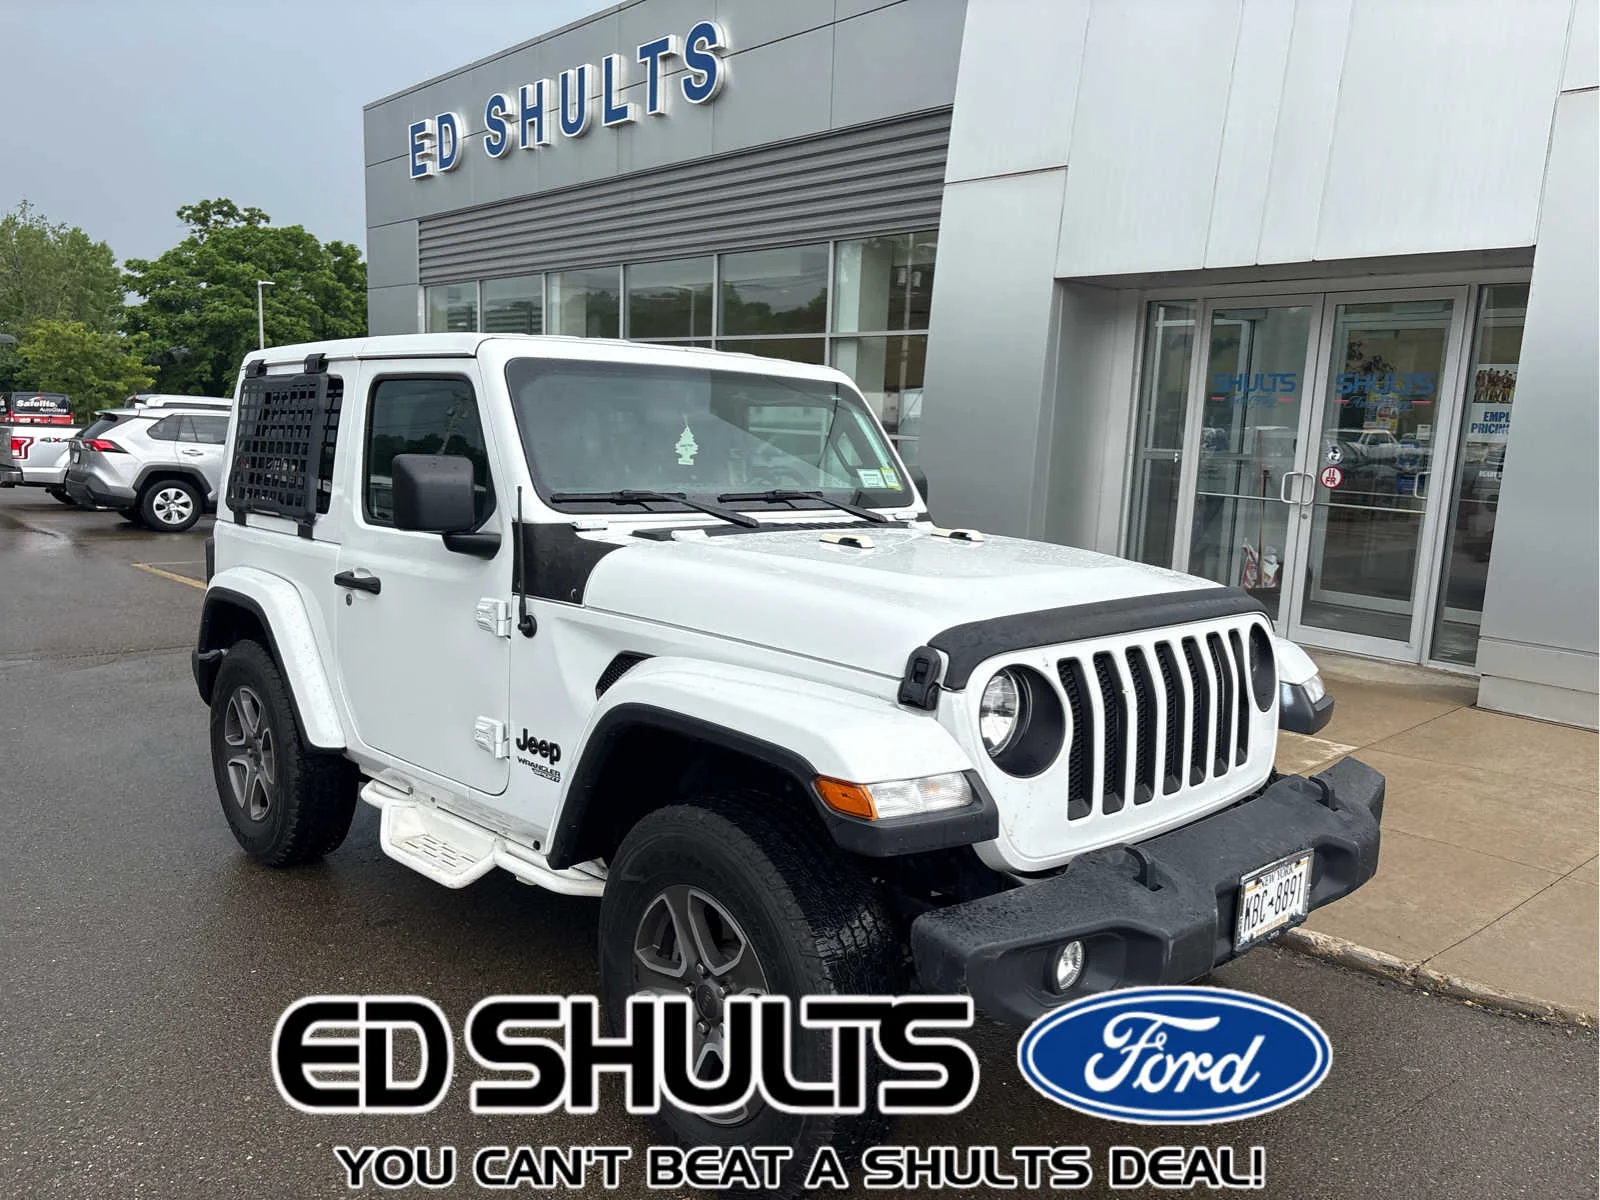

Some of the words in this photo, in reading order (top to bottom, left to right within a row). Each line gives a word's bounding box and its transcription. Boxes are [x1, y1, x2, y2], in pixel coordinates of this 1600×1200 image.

[408, 111, 463, 179] ED
[483, 20, 728, 159] SHULTS
[1213, 373, 1297, 393] SHULTS
[1335, 372, 1435, 395] SHULTS
[516, 728, 561, 765] Jeep
